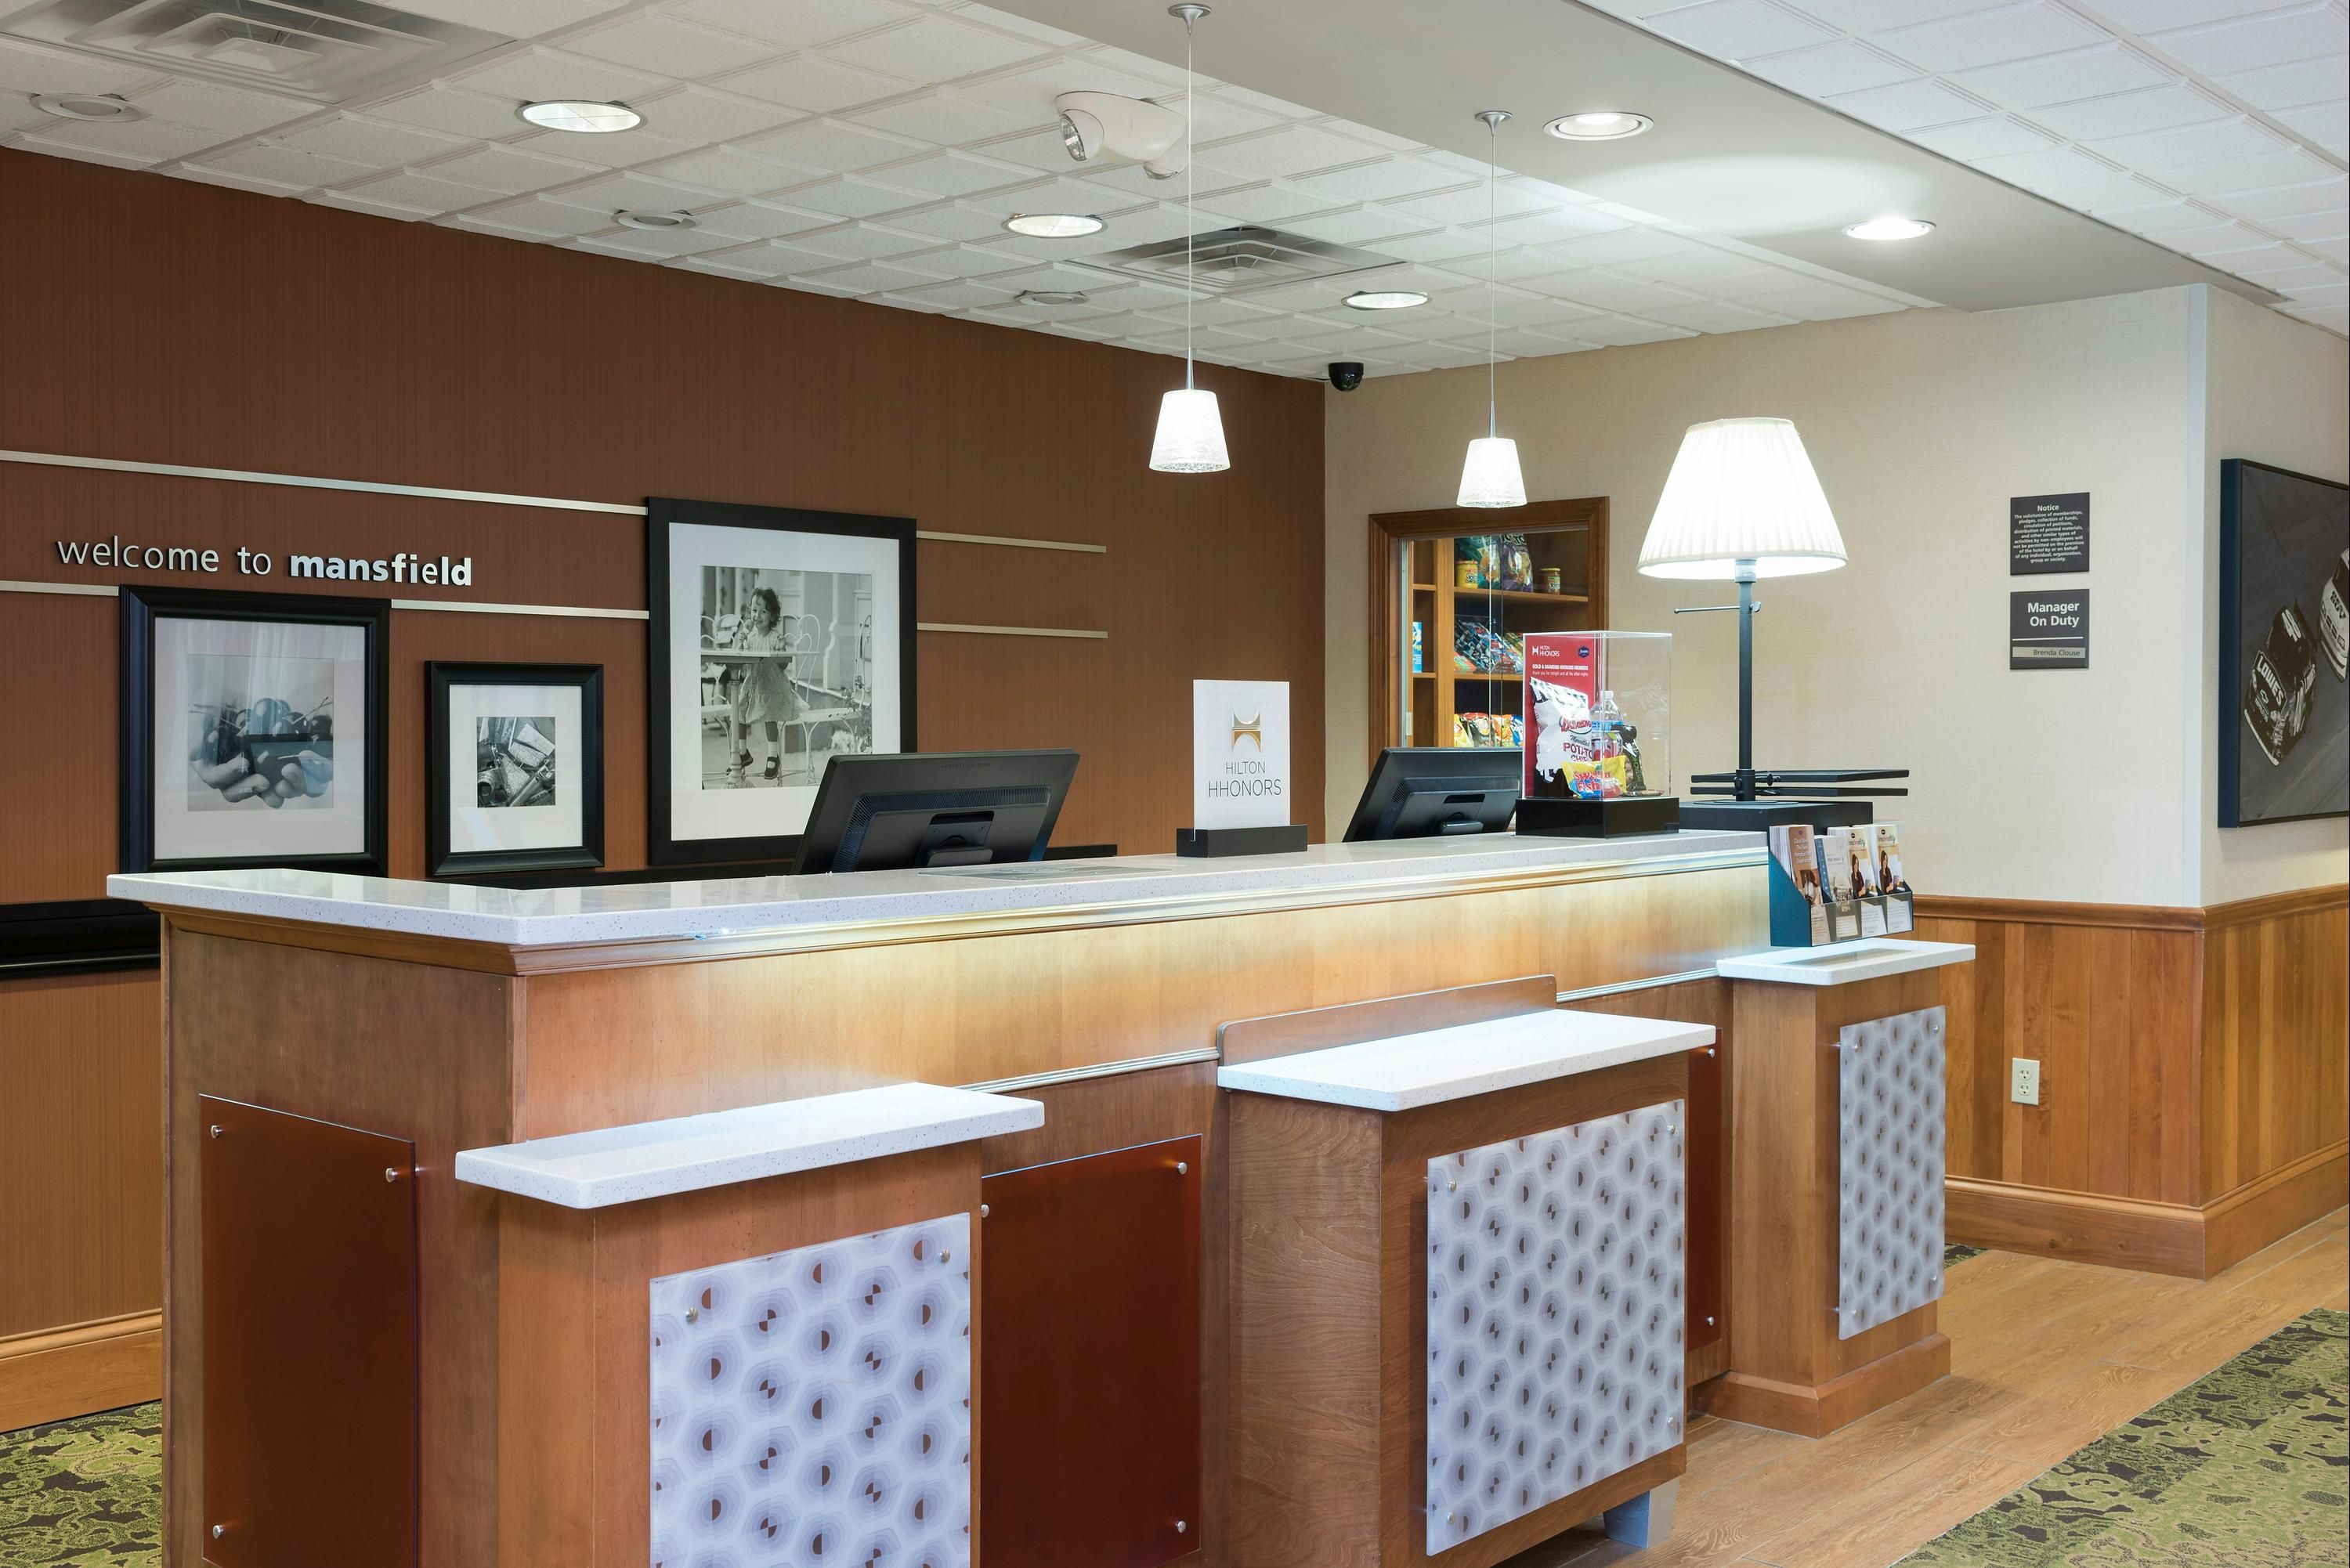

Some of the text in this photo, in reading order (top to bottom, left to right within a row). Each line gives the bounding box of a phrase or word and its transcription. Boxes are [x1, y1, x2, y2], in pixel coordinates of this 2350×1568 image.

[57, 536, 472, 586] welcome to mansfield
[2027, 602, 2080, 614] Manager
[2030, 615, 2080, 627] On Duty
[1226, 761, 1265, 775] HILTON
[1209, 779, 1282, 797] HHONORS
